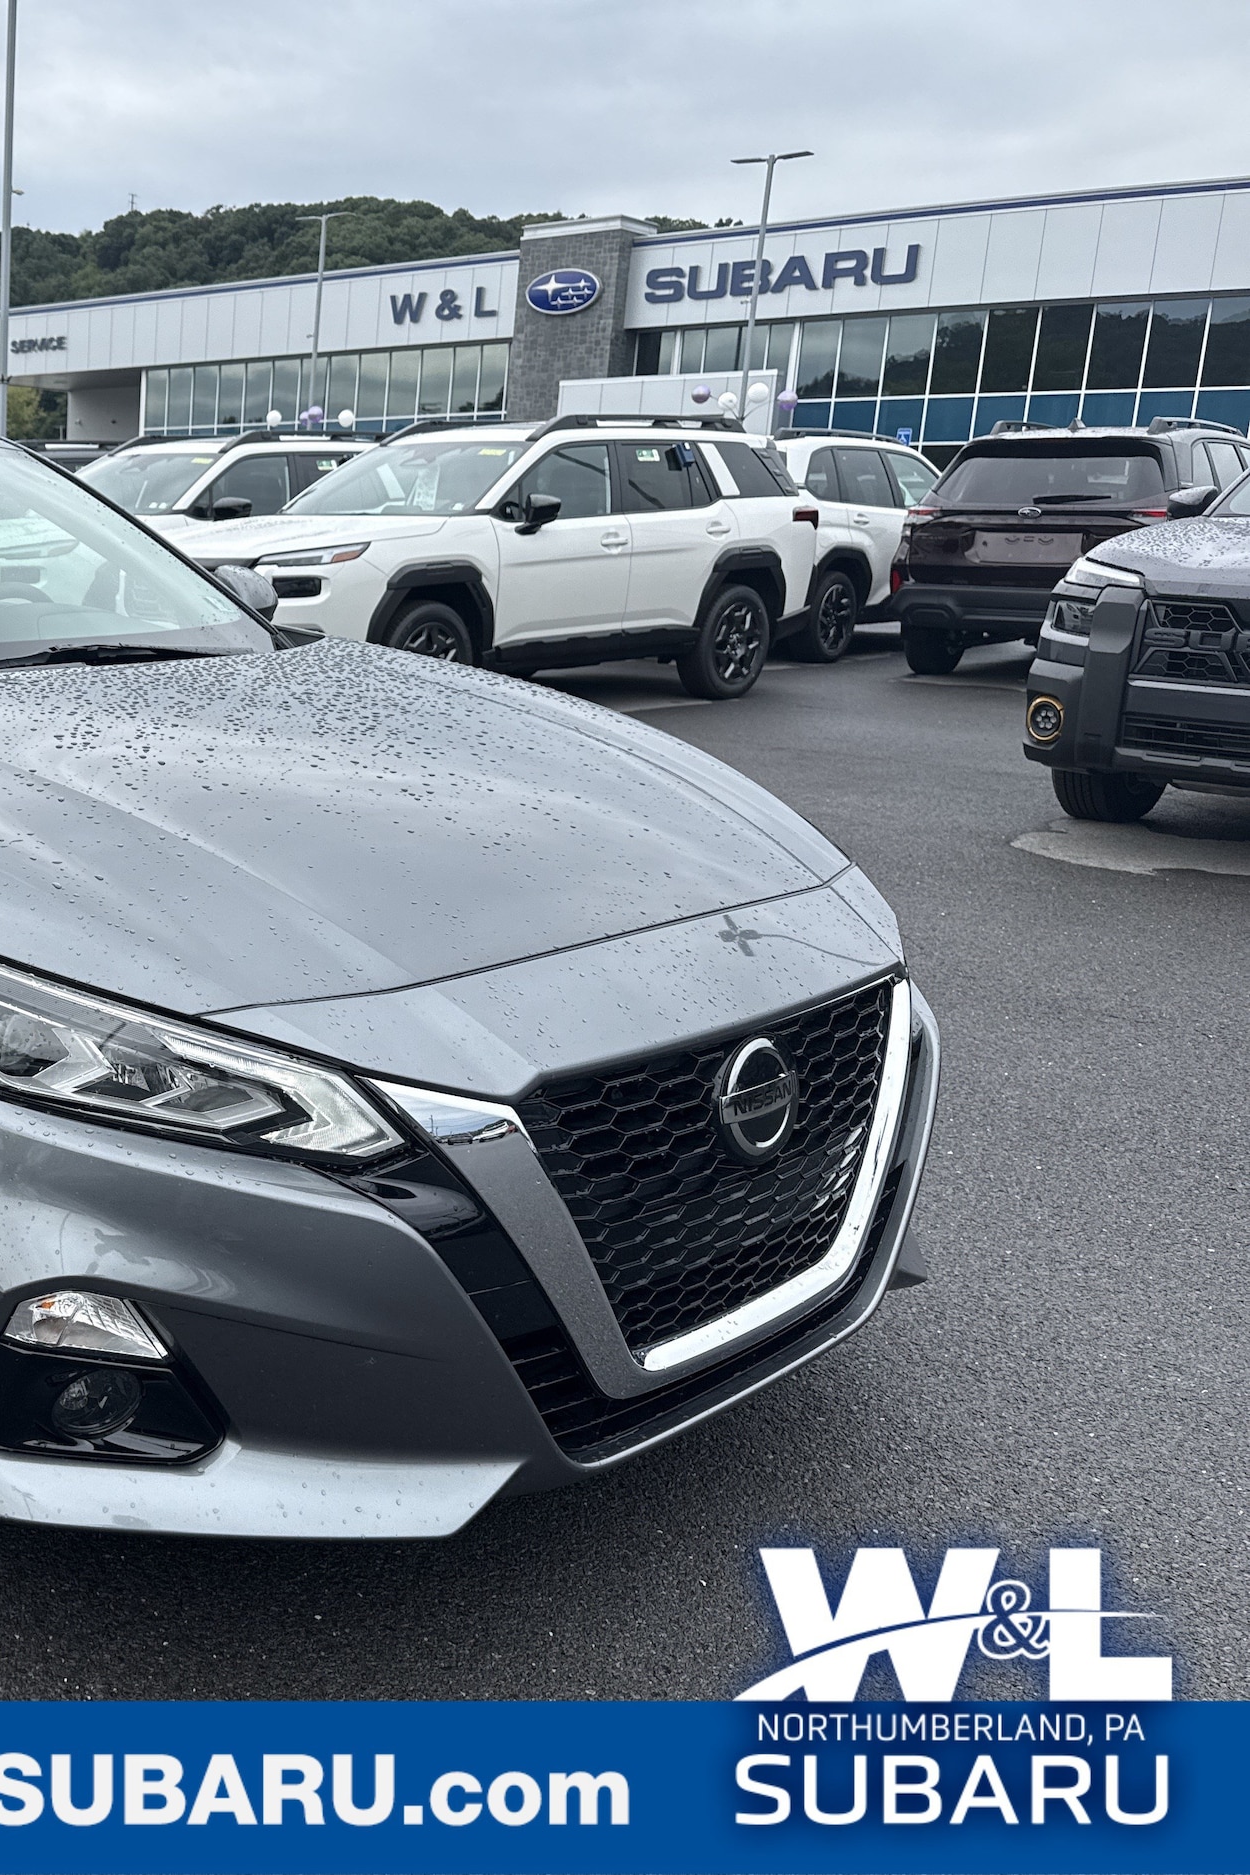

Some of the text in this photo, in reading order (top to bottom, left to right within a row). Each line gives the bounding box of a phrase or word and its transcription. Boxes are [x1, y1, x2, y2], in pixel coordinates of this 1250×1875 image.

[644, 243, 921, 304] SUBARU
[390, 286, 497, 325] W & L
[10, 336, 67, 354] SERVICE
[733, 1081, 792, 1116] NISSAN
